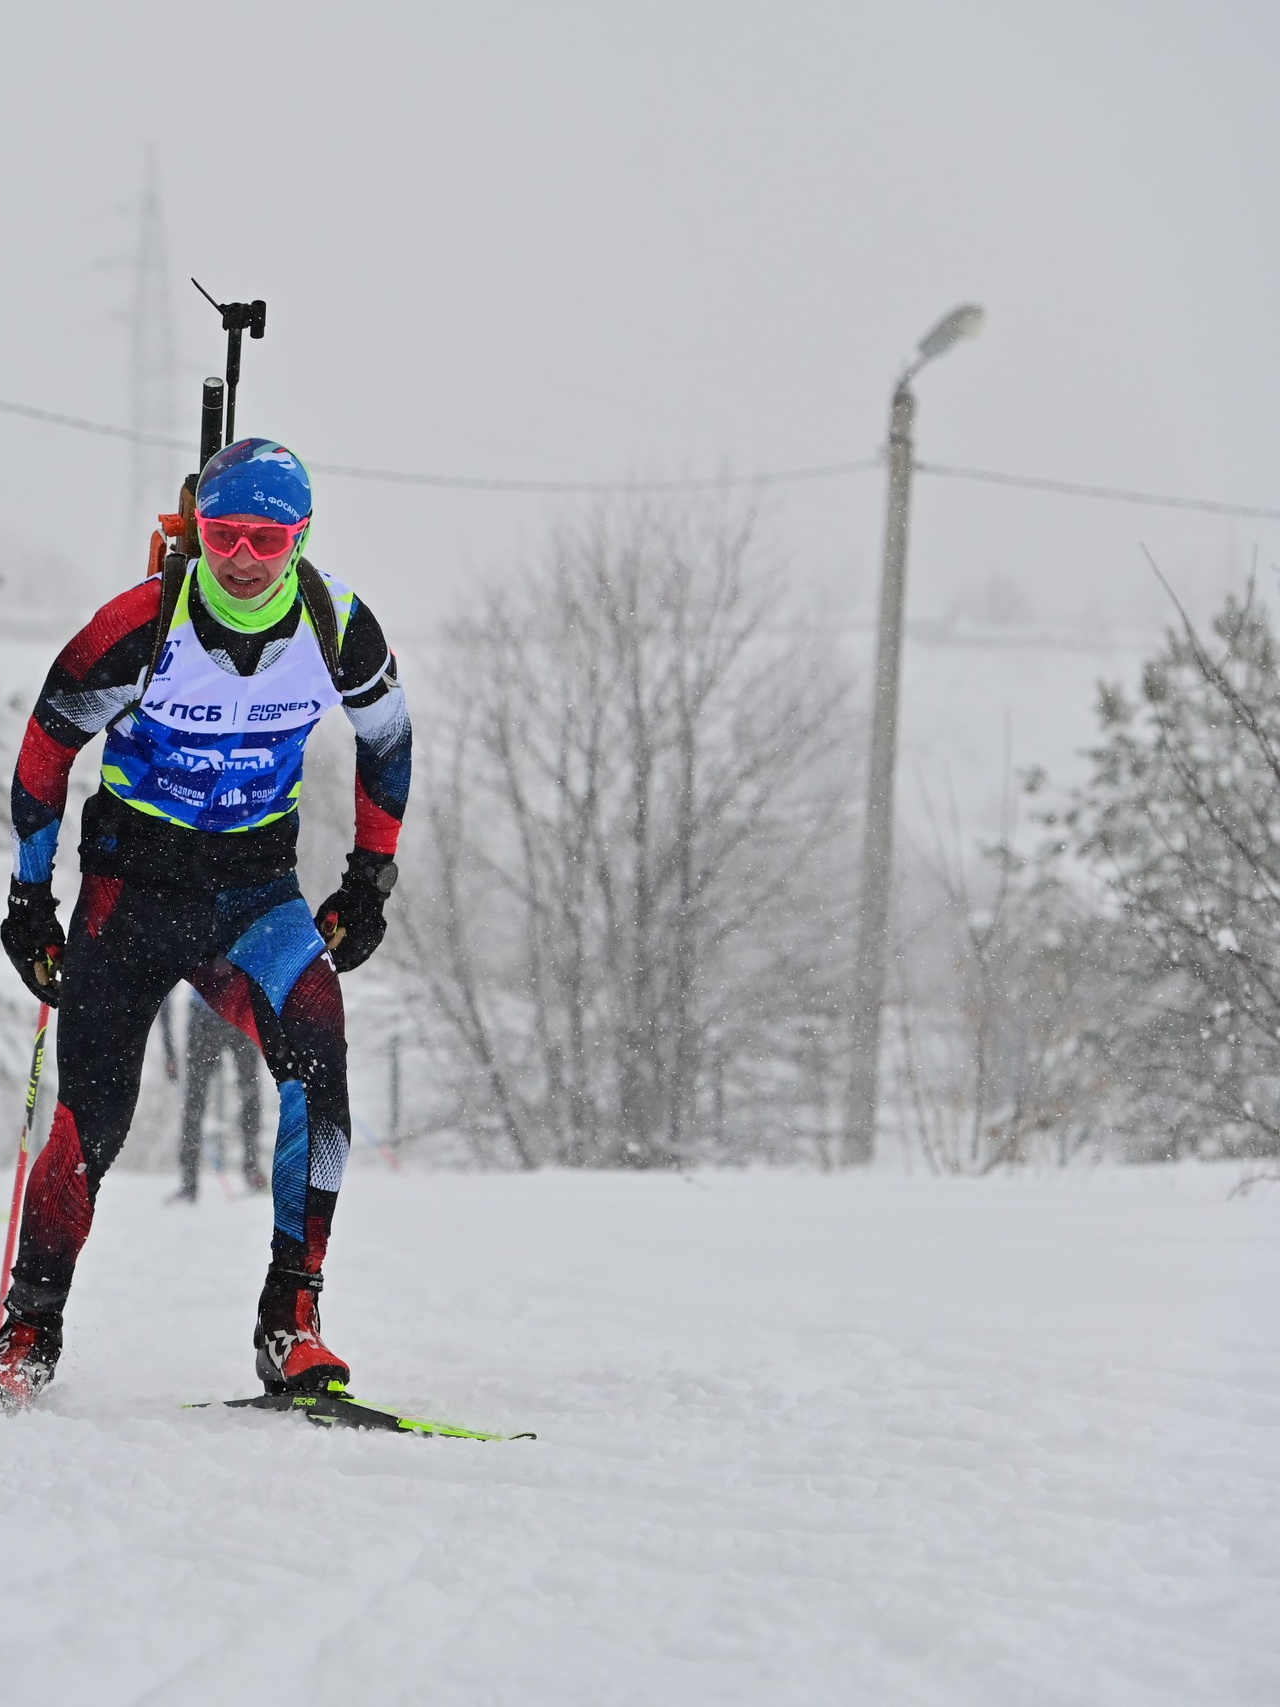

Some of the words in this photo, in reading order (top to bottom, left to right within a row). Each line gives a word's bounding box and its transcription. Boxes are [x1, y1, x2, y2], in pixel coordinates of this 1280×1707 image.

[267, 496, 301, 521] ФОСАГРО
[169, 703, 222, 722] ПСБ
[250, 702, 309, 713] PIONER
[247, 713, 282, 722] CUP
[292, 1397, 317, 1406] FISCHER
